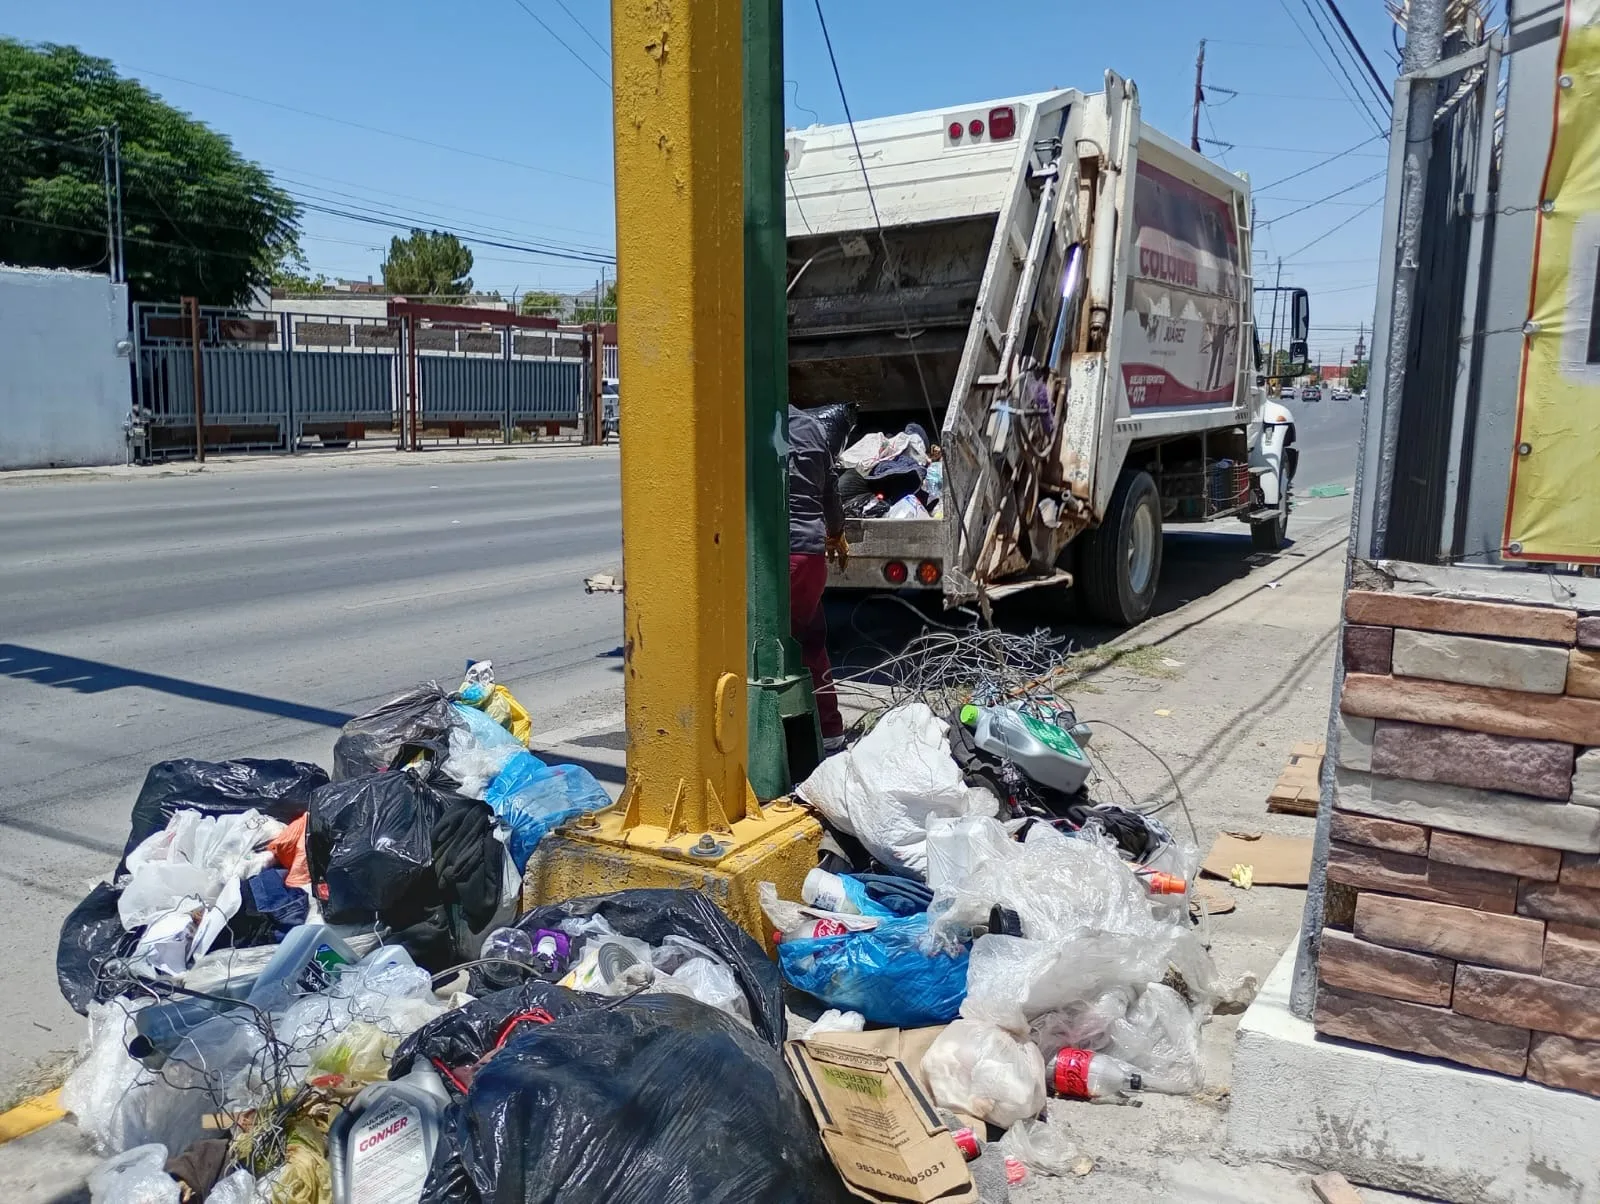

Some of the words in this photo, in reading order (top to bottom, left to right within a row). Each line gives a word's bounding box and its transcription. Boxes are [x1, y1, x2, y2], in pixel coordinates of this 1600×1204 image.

[824, 1067, 882, 1088] ALLERGEN
[846, 1081, 872, 1094] MILK
[359, 1116, 408, 1152] GONHER
